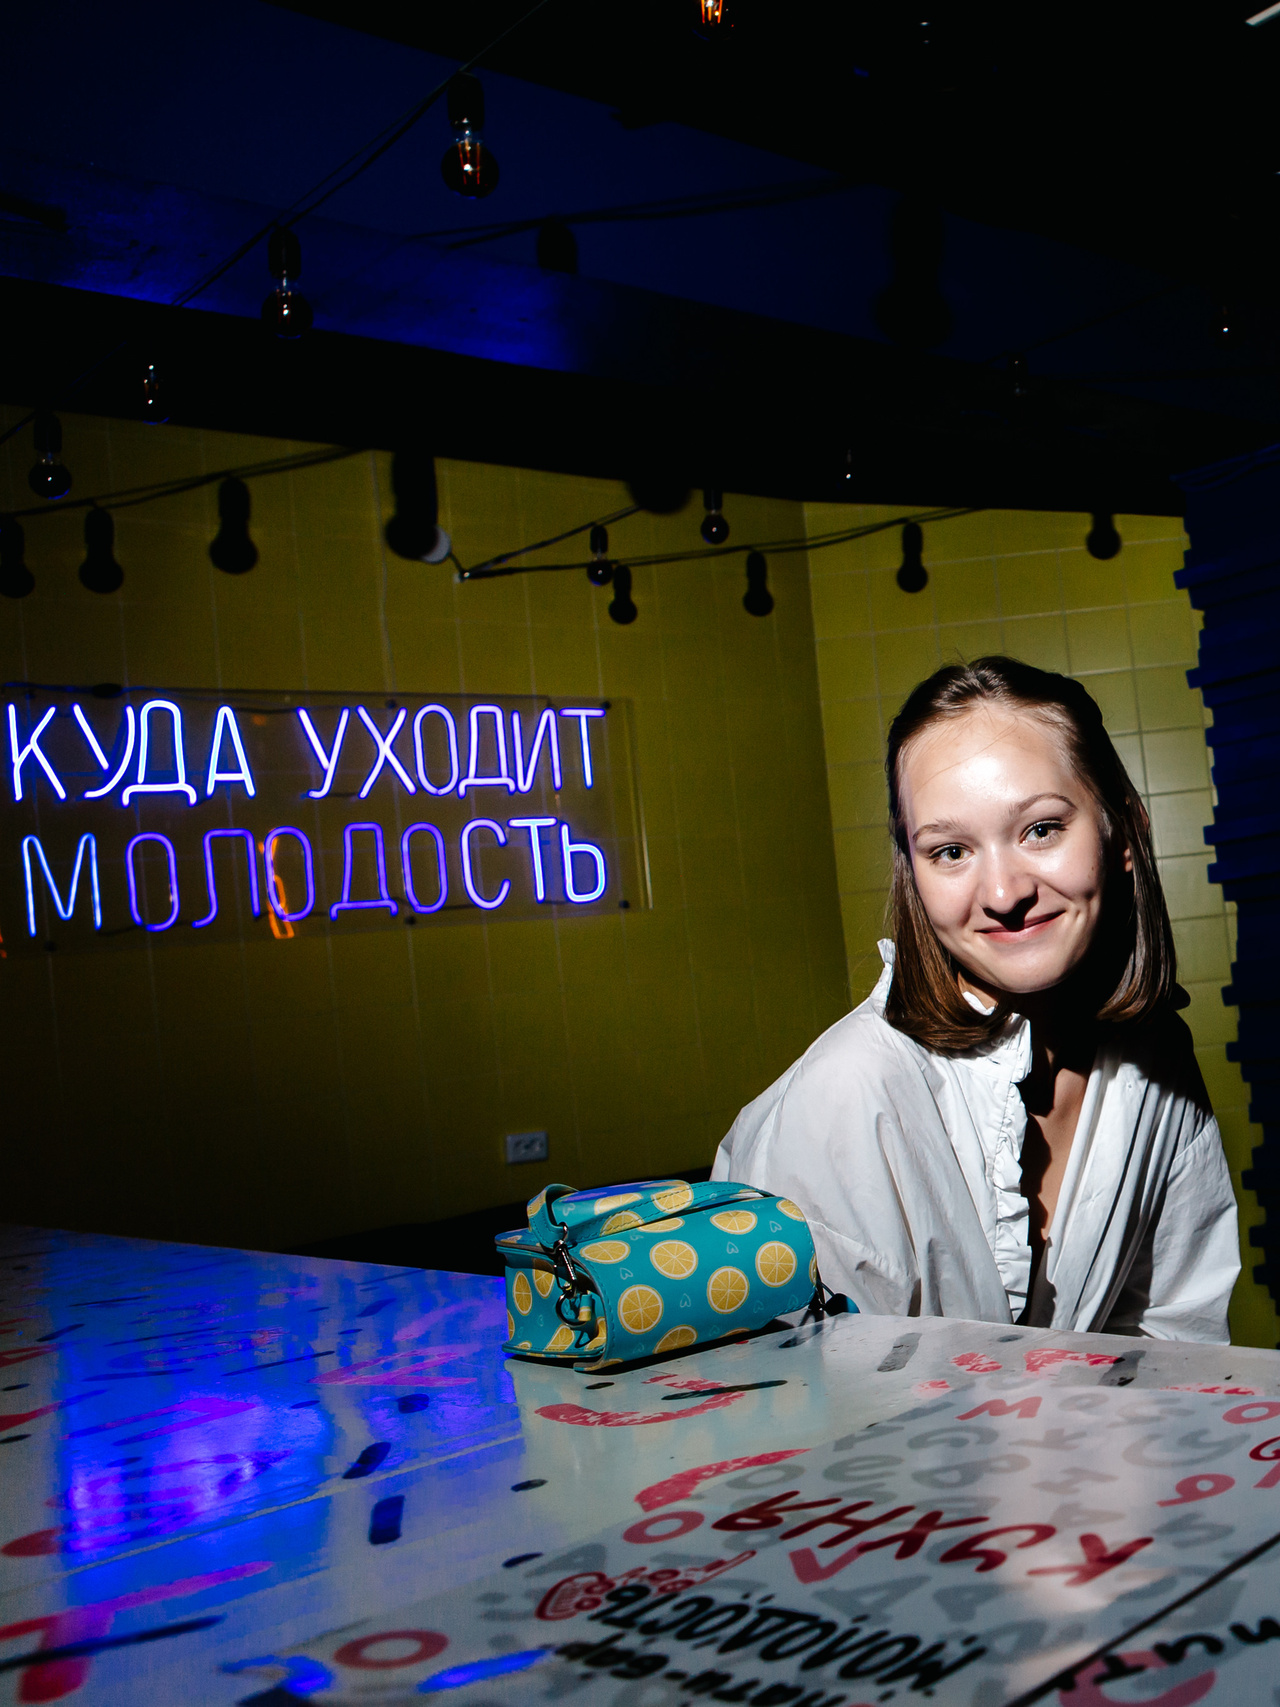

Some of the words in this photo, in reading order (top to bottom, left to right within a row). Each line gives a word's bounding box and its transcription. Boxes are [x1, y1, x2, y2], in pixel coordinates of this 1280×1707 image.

[6, 699, 257, 807] КУДА
[296, 703, 606, 799] УХОДИТ
[20, 815, 607, 937] МОЛОДОСТЬ
[711, 1490, 1154, 1587] КУХНЯ
[589, 1583, 988, 1690] МОЛОДОСТЬ
